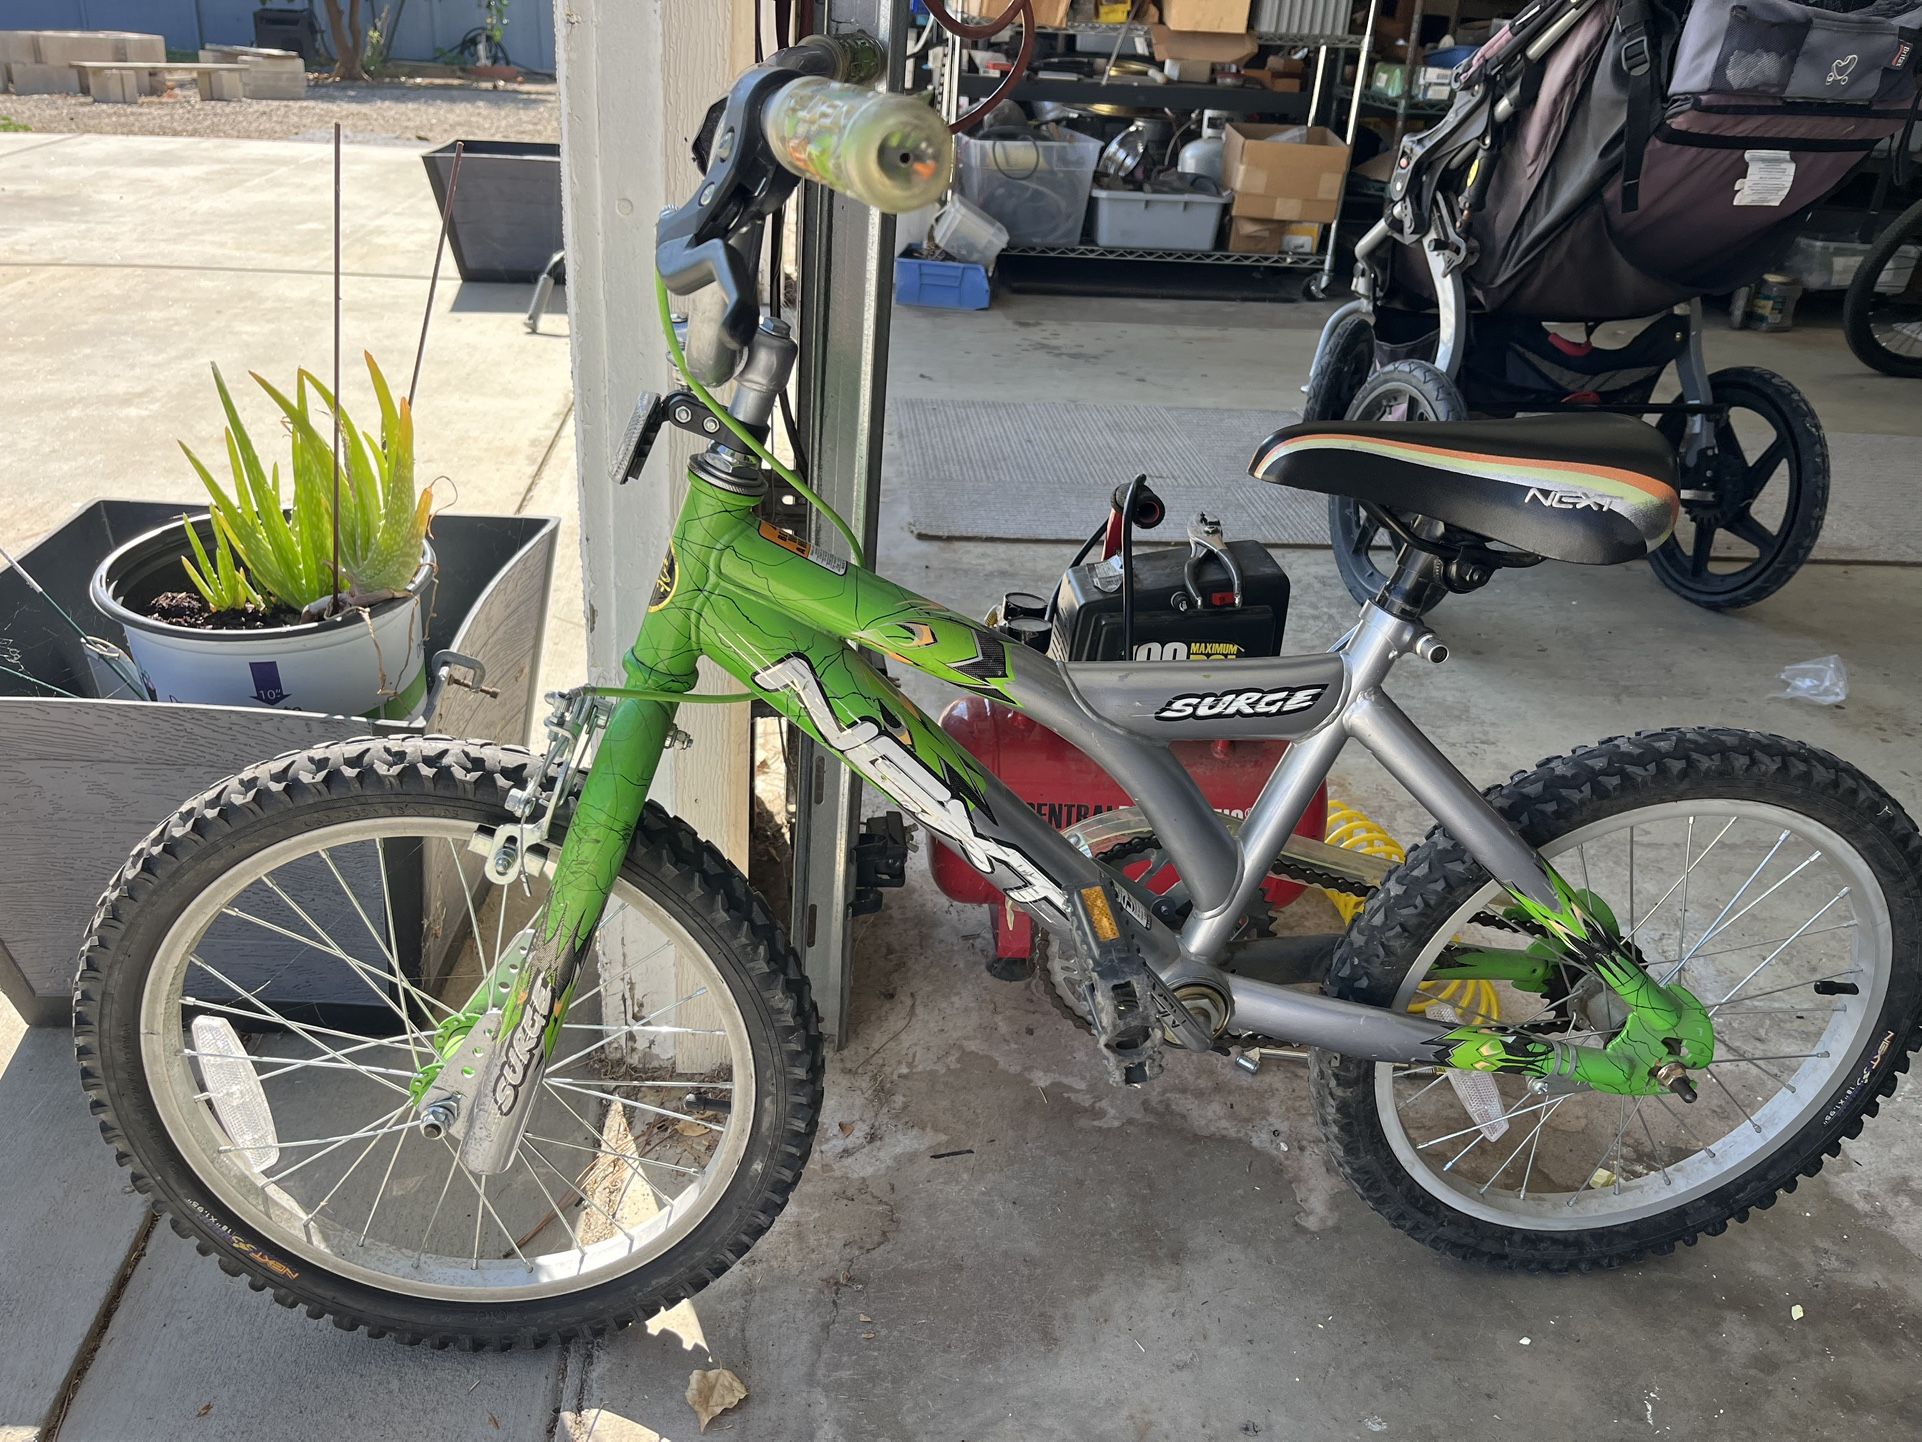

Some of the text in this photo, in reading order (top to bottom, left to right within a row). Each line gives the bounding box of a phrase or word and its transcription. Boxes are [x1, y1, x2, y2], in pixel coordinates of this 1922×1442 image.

[1524, 487, 1625, 512] NEXT
[1190, 642, 1238, 655] MAXIMUM
[1159, 687, 1322, 718] SURGE
[752, 656, 1069, 913] NEXT
[496, 970, 552, 1115] SURGE
[1869, 1029, 1896, 1070] NEXT
[248, 1251, 300, 1281] NEXT
